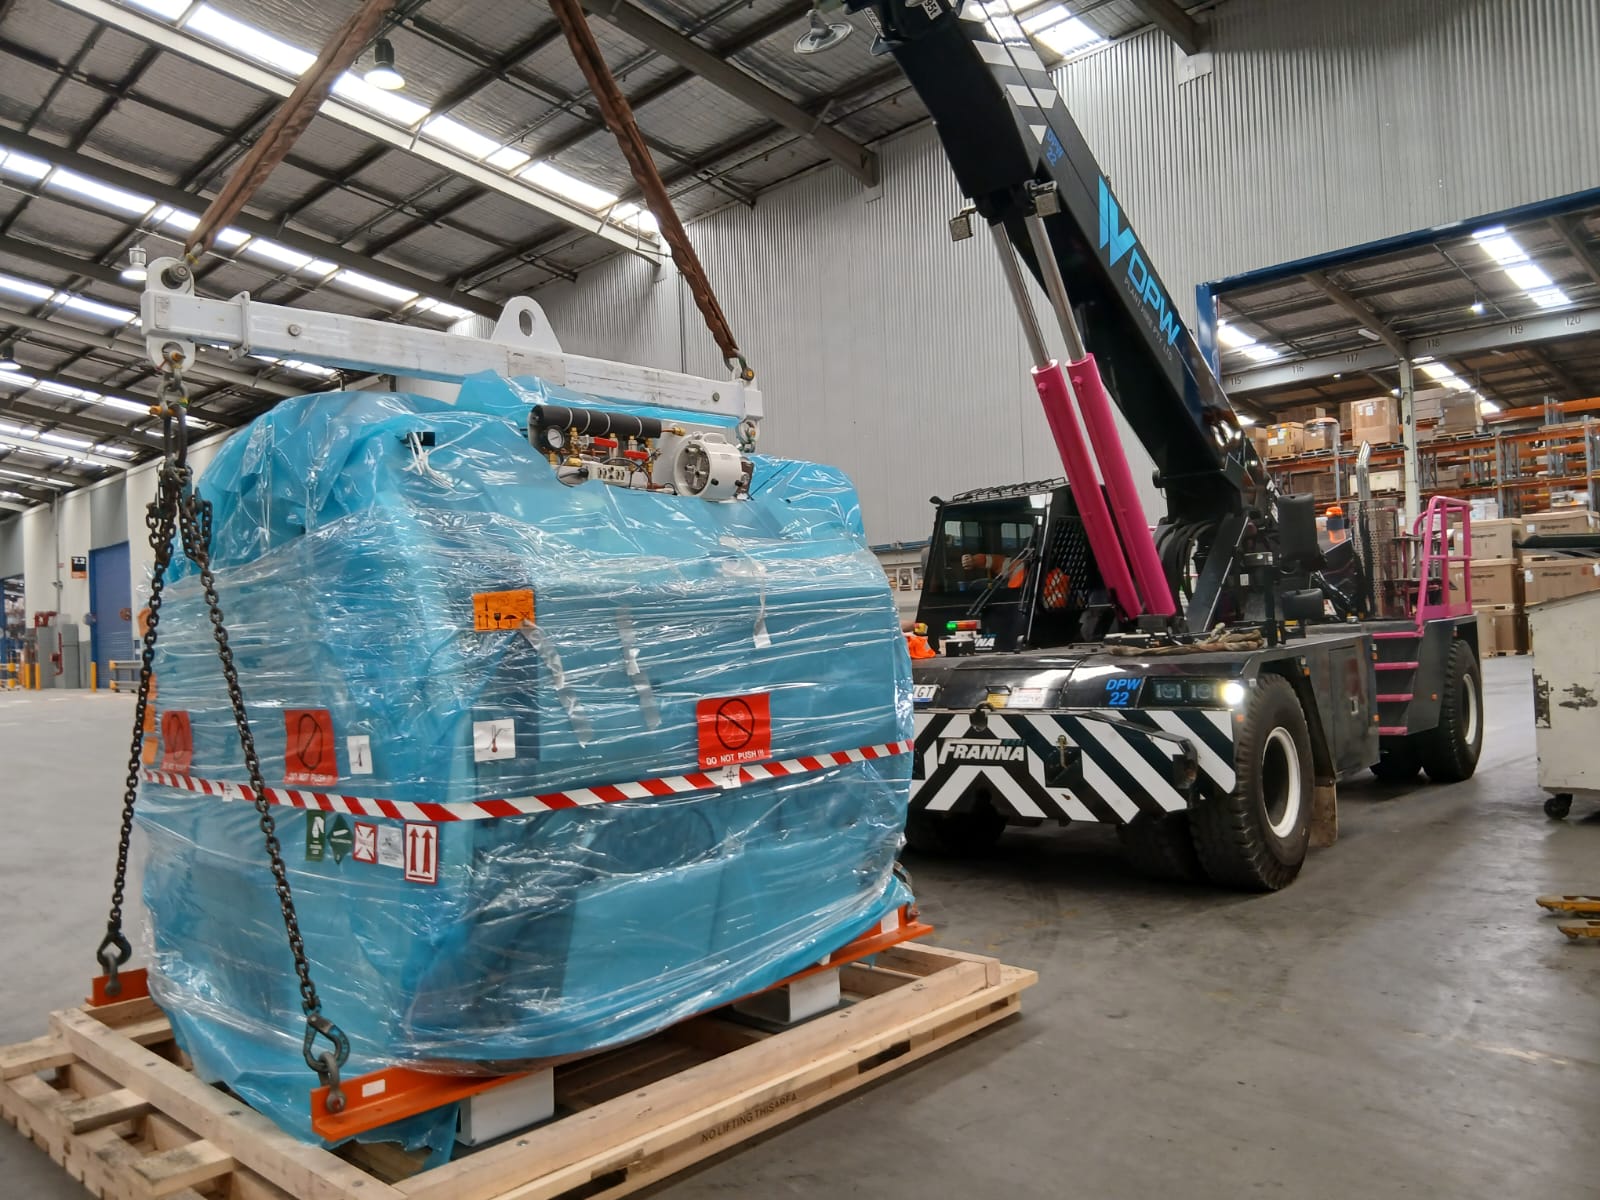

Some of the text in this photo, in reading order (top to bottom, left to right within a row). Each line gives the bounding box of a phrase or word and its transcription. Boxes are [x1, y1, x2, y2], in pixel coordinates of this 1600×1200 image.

[1124, 277, 1143, 307] PLANT
[1127, 248, 1180, 346] DPW
[1565, 316, 1581, 327] 120
[1509, 324, 1524, 335] 119
[1231, 377, 1242, 386] 115
[1105, 679, 1142, 691] DPW
[1109, 691, 1130, 705] 22
[706, 757, 717, 765] DO
[720, 753, 735, 763] NOT
[738, 750, 757, 760] PUSH
[938, 739, 1025, 764] FRANNA
[717, 1112, 753, 1136] LIFTING
